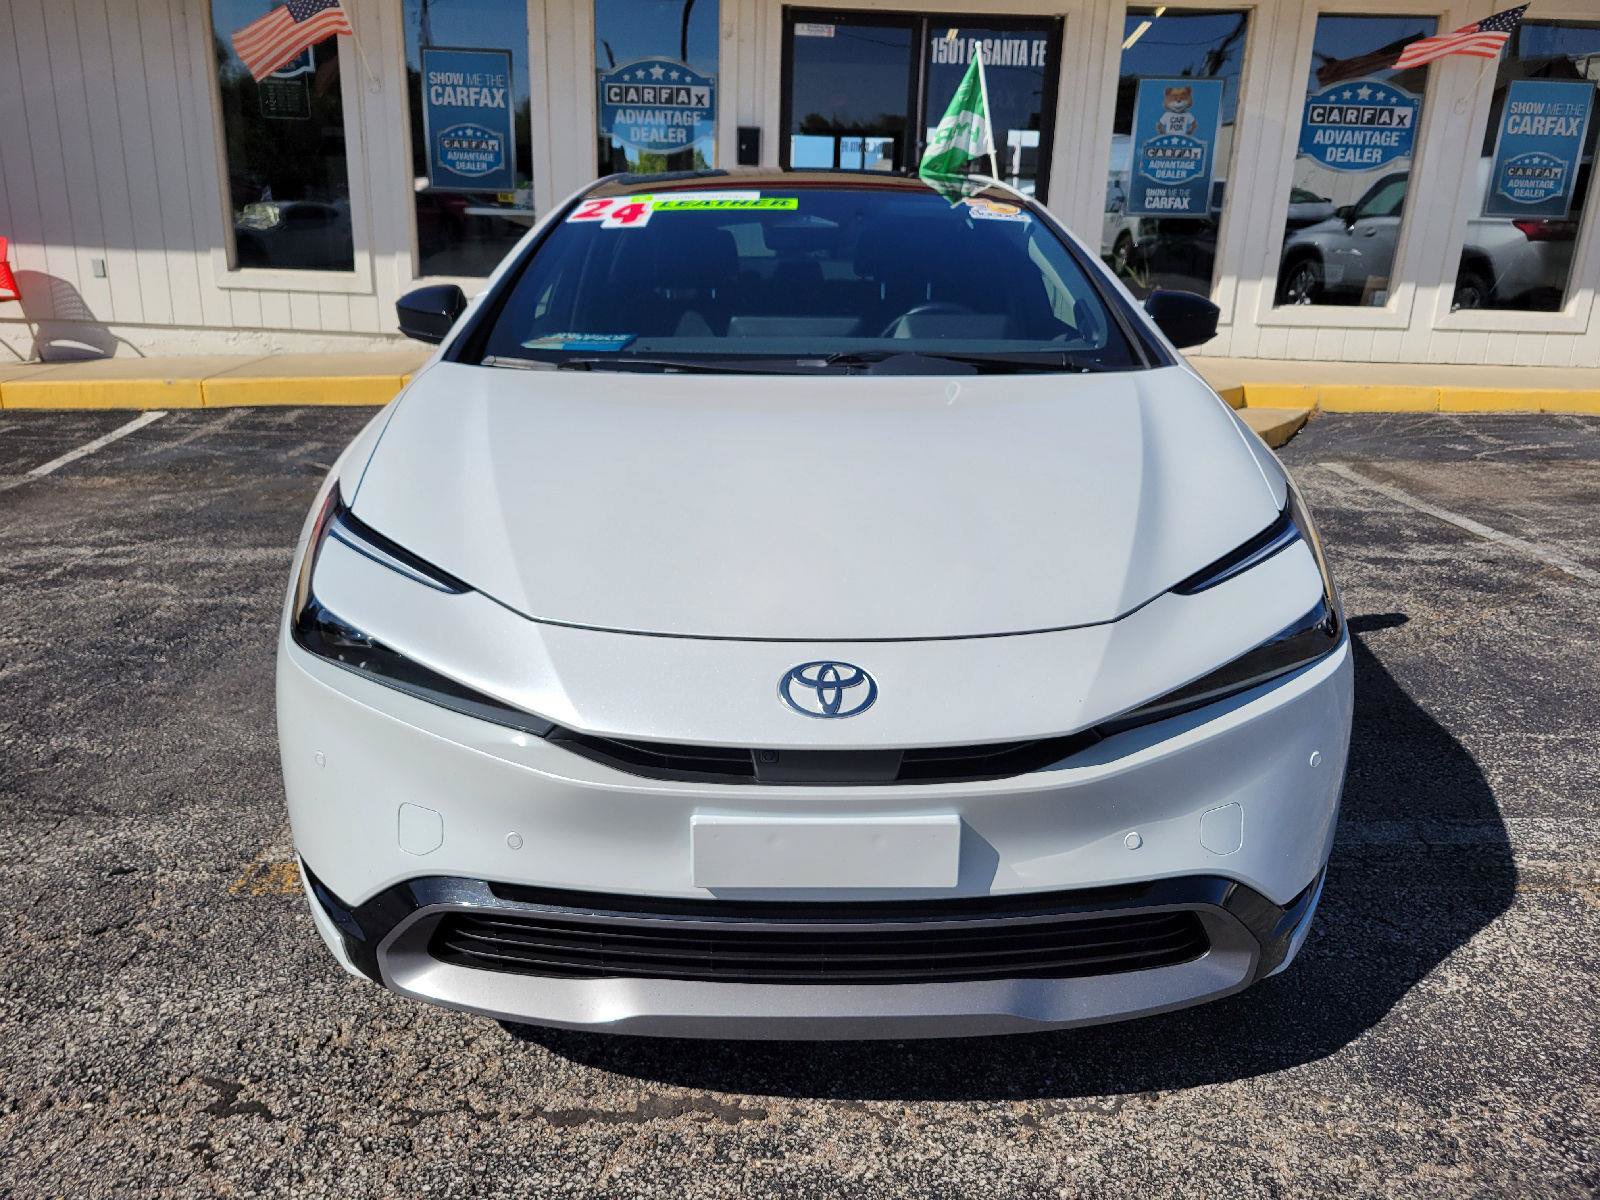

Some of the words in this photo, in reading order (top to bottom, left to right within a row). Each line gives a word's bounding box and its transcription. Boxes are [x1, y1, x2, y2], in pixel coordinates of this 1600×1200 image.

[931, 37, 965, 64] 1501
[982, 38, 1028, 66] SANTA
[1031, 40, 1048, 67] FE
[428, 71, 463, 86] SHOW
[466, 72, 481, 86] ME
[484, 73, 504, 88] THE
[430, 85, 506, 108] CARFAX
[608, 86, 705, 107] CARFAX
[1510, 101, 1545, 114] SHOW
[1546, 103, 1562, 115] ME
[1564, 104, 1585, 117] THE
[614, 108, 701, 126] ADVANTAGE
[1169, 116, 1185, 124] CAR
[1311, 108, 1408, 126] CARFAX
[1507, 114, 1580, 136] CARFAX
[629, 126, 687, 143] DEALER
[1313, 129, 1400, 146] ADVANTAGE
[443, 139, 498, 151] CARFAX
[447, 151, 495, 162] ADVANTAGE
[1146, 148, 1200, 159] CARFAX
[1325, 147, 1383, 163] DEALER
[455, 161, 488, 171] DEALER
[1148, 160, 1196, 170] ADVANTAGE
[1155, 169, 1188, 179] DEALER
[1507, 167, 1561, 179] CARFAX
[1507, 179, 1554, 189] ADVANTAGE
[1145, 187, 1167, 197] SHOW
[1514, 188, 1545, 198] DEALER
[659, 200, 791, 208] LEATHER
[1144, 196, 1190, 209] CARFAX
[571, 199, 645, 225] 24
